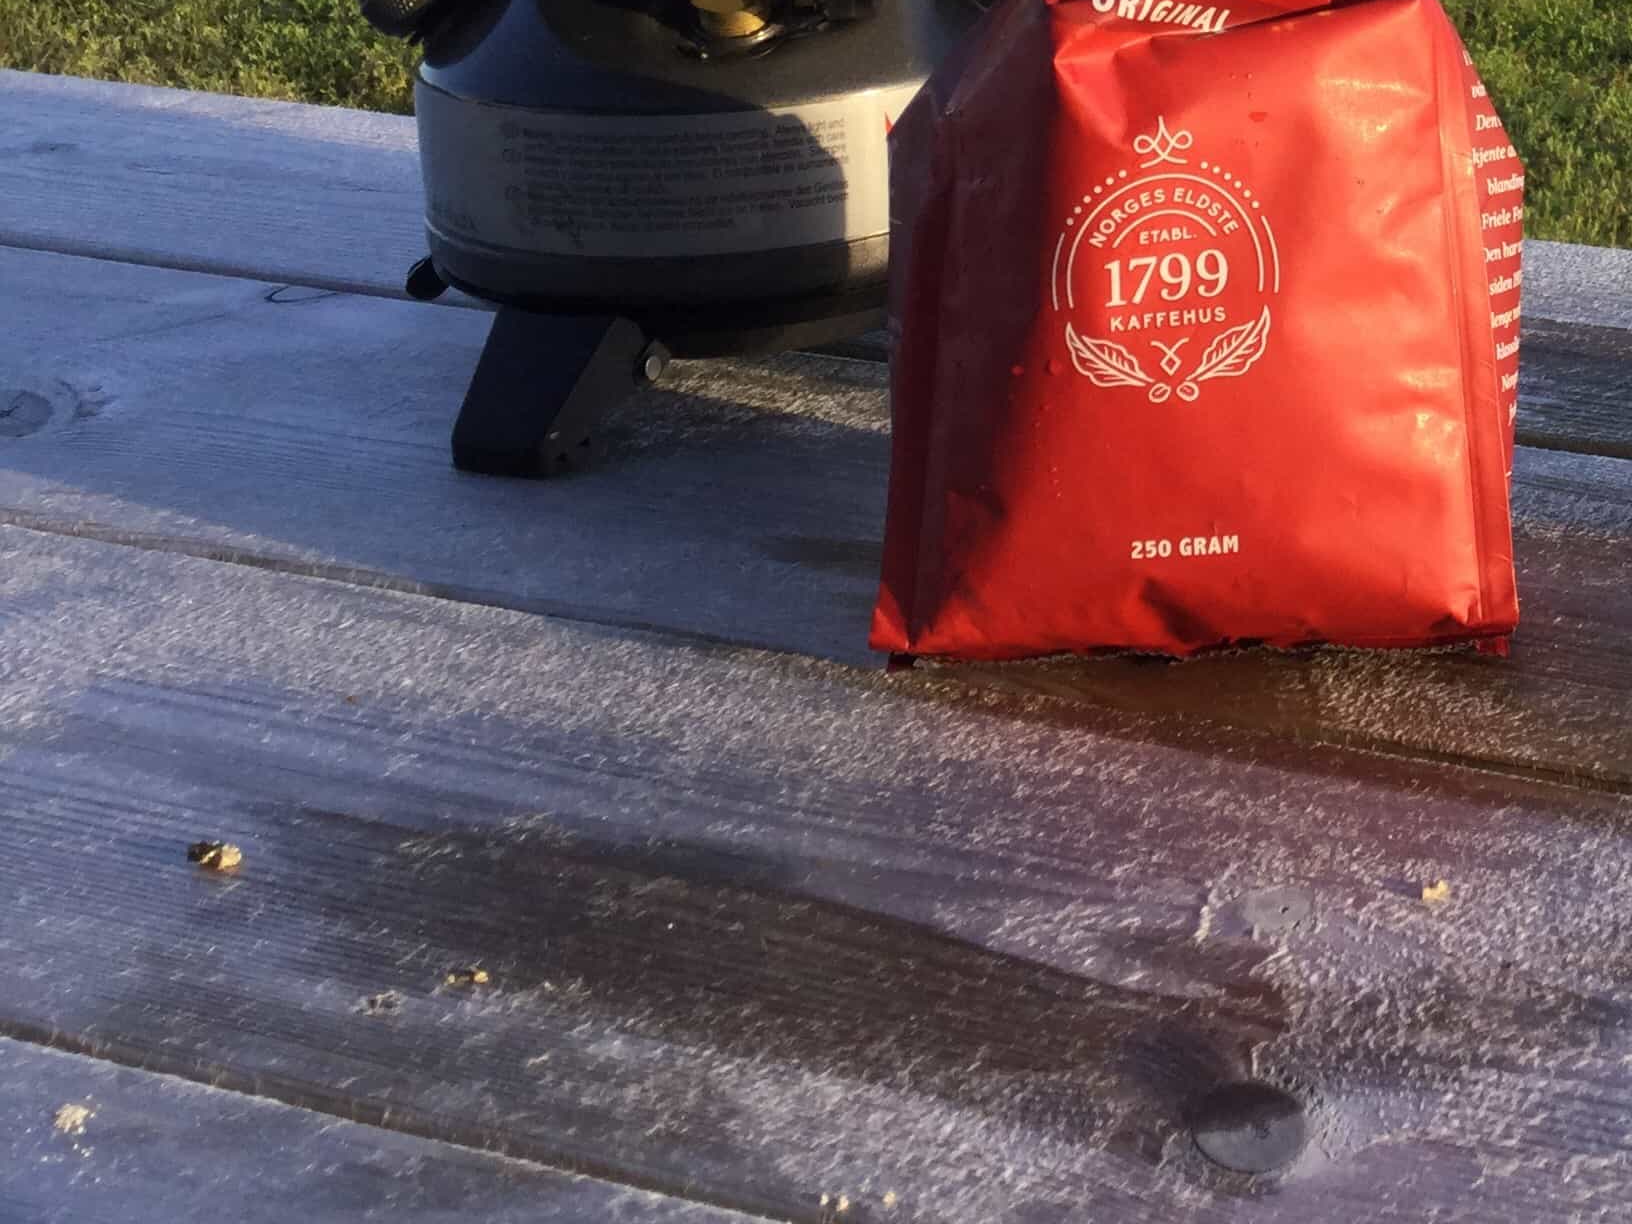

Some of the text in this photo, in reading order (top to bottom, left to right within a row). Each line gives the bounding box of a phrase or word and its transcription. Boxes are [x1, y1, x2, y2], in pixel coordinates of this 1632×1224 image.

[1089, 187, 1239, 249] NORGES ELDSTE
[1481, 207, 1512, 230] Friele
[1139, 227, 1198, 245] ETABL.
[1104, 248, 1229, 308] 1799
[1110, 306, 1226, 332] KAFFEHUS
[1131, 534, 1240, 560] 250 GRAM
